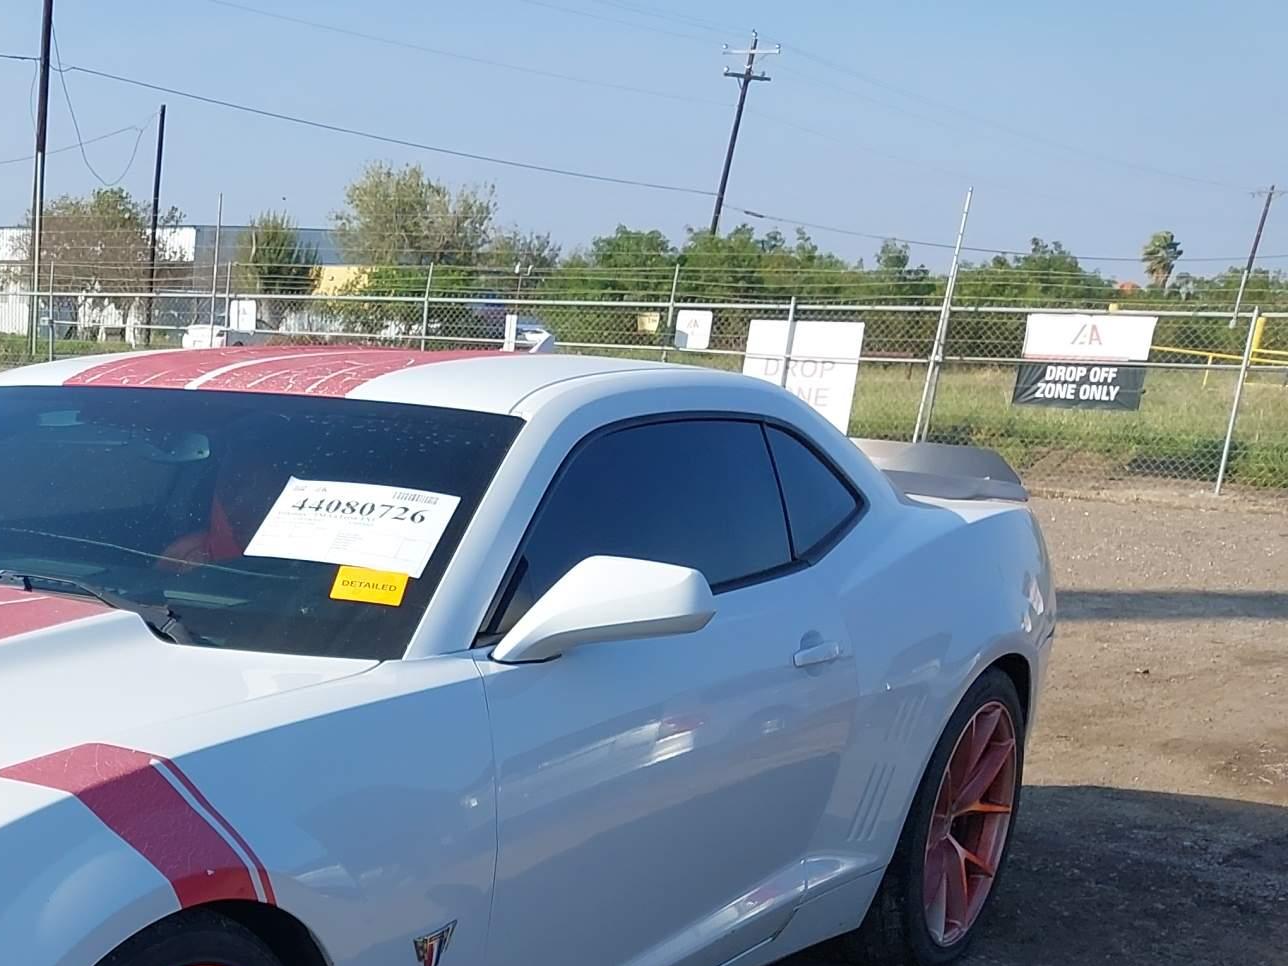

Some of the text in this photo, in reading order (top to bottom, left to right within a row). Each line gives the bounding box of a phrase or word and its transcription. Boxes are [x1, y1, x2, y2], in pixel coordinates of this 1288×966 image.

[1044, 365, 1119, 384] DROP OFF
[1033, 382, 1120, 401] ZONE ONLY
[291, 497, 430, 525] 44080726
[341, 579, 397, 592] DETAILED
